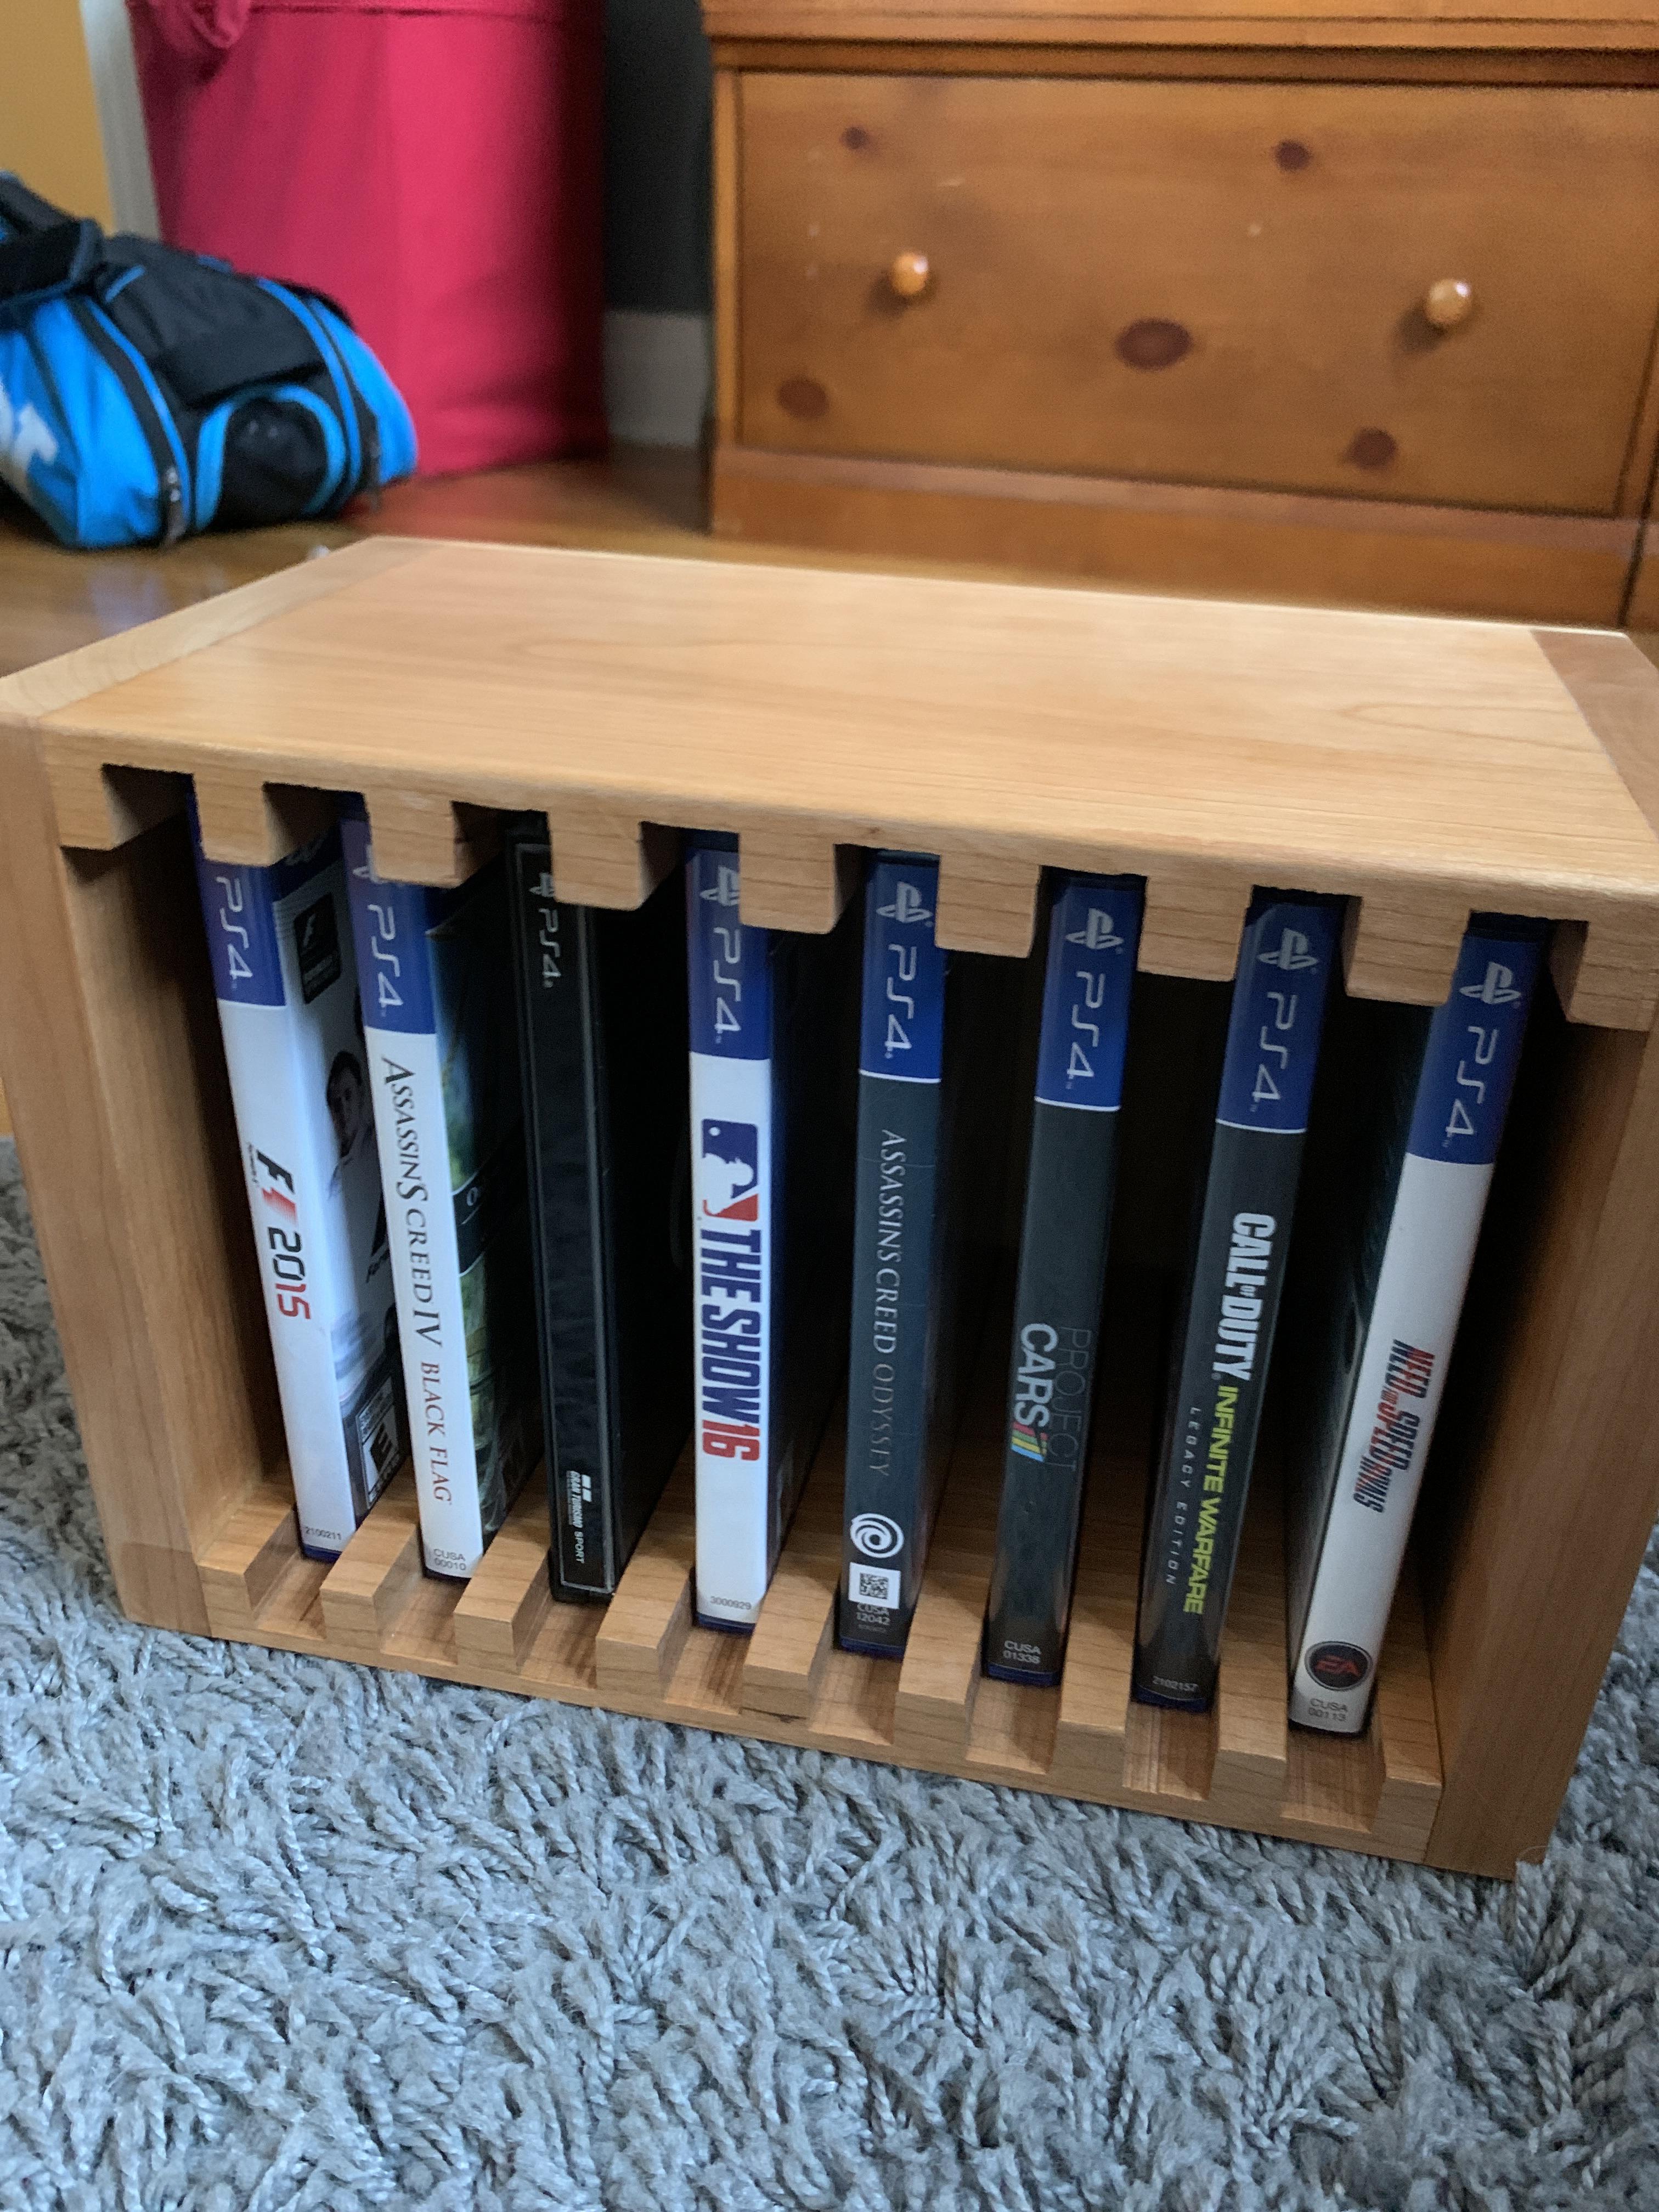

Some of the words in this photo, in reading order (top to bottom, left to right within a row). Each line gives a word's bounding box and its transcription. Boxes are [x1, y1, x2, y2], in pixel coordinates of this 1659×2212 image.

[217, 877, 253, 980] PS4
[368, 904, 403, 1008] PS4
[539, 907, 561, 980] PS4
[713, 927, 742, 1032] PS4
[884, 943, 917, 1050] PS4
[1066, 970, 1105, 1078] PS4
[1251, 991, 1296, 1102] PS4
[1446, 1025, 1498, 1136] PS4
[267, 1227, 311, 1319] 2015
[405, 1209, 434, 1303] CREED
[699, 1229, 761, 1303] THE
[1224, 1212, 1277, 1288] CALL
[413, 1307, 443, 1348] IV
[873, 1267, 900, 1353] CREED
[1212, 1295, 1262, 1381] DUTY
[420, 1361, 446, 1436] BLACK
[701, 1304, 761, 1424] SHOW
[1013, 1323, 1059, 1427] CARS
[1046, 1327, 1092, 1472] PROJECT
[1385, 1338, 1435, 1398] NEED
[428, 1446, 453, 1502] FLAG
[702, 1420, 760, 1462] 16
[1180, 1407, 1201, 1488] LEGACY
[1202, 1385, 1239, 1493] INFINITE
[1369, 1402, 1420, 1470] SPEED
[1353, 1455, 1392, 1513] RIVALS
[433, 1548, 466, 1561] CUSA
[574, 1531, 585, 1564] SPORT
[1165, 1500, 1188, 1585] EDITION
[1182, 1497, 1222, 1615] WARFARE
[1004, 1640, 1042, 1655] CUSA
[1310, 1698, 1348, 1712] CUSA
